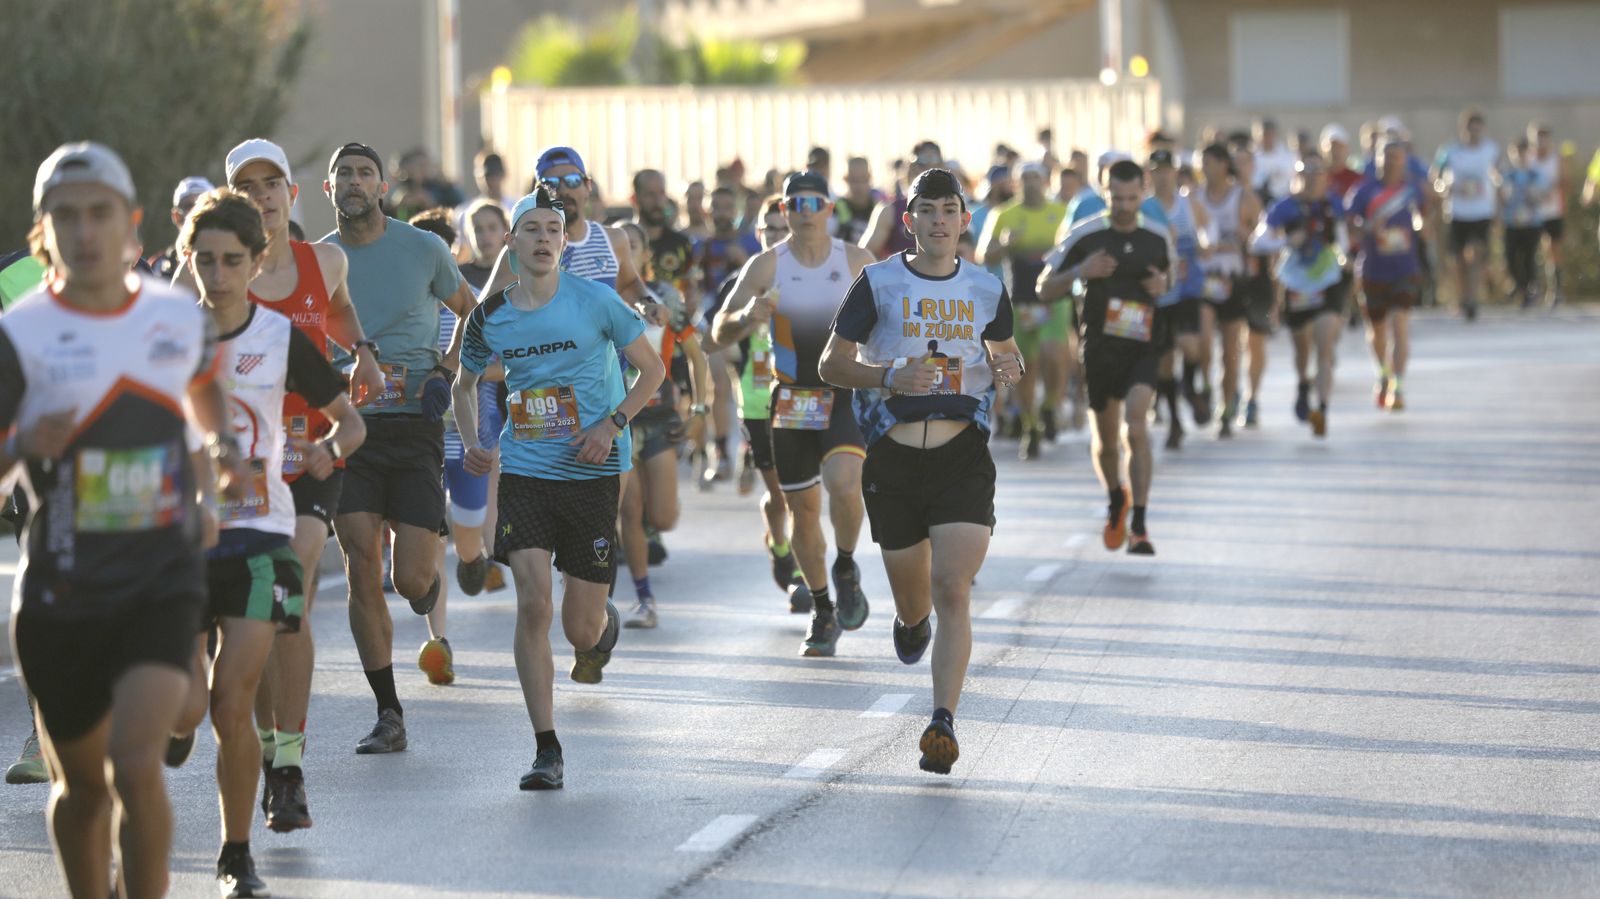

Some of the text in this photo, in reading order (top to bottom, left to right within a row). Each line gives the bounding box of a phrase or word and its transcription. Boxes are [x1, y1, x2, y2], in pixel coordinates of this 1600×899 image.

[902, 297, 974, 322] I RUN
[903, 320, 974, 341] IN ZÚJAR
[502, 340, 578, 359] SCARPA
[526, 396, 558, 416] 499
[793, 396, 818, 412] 376
[557, 418, 576, 427] 2023
